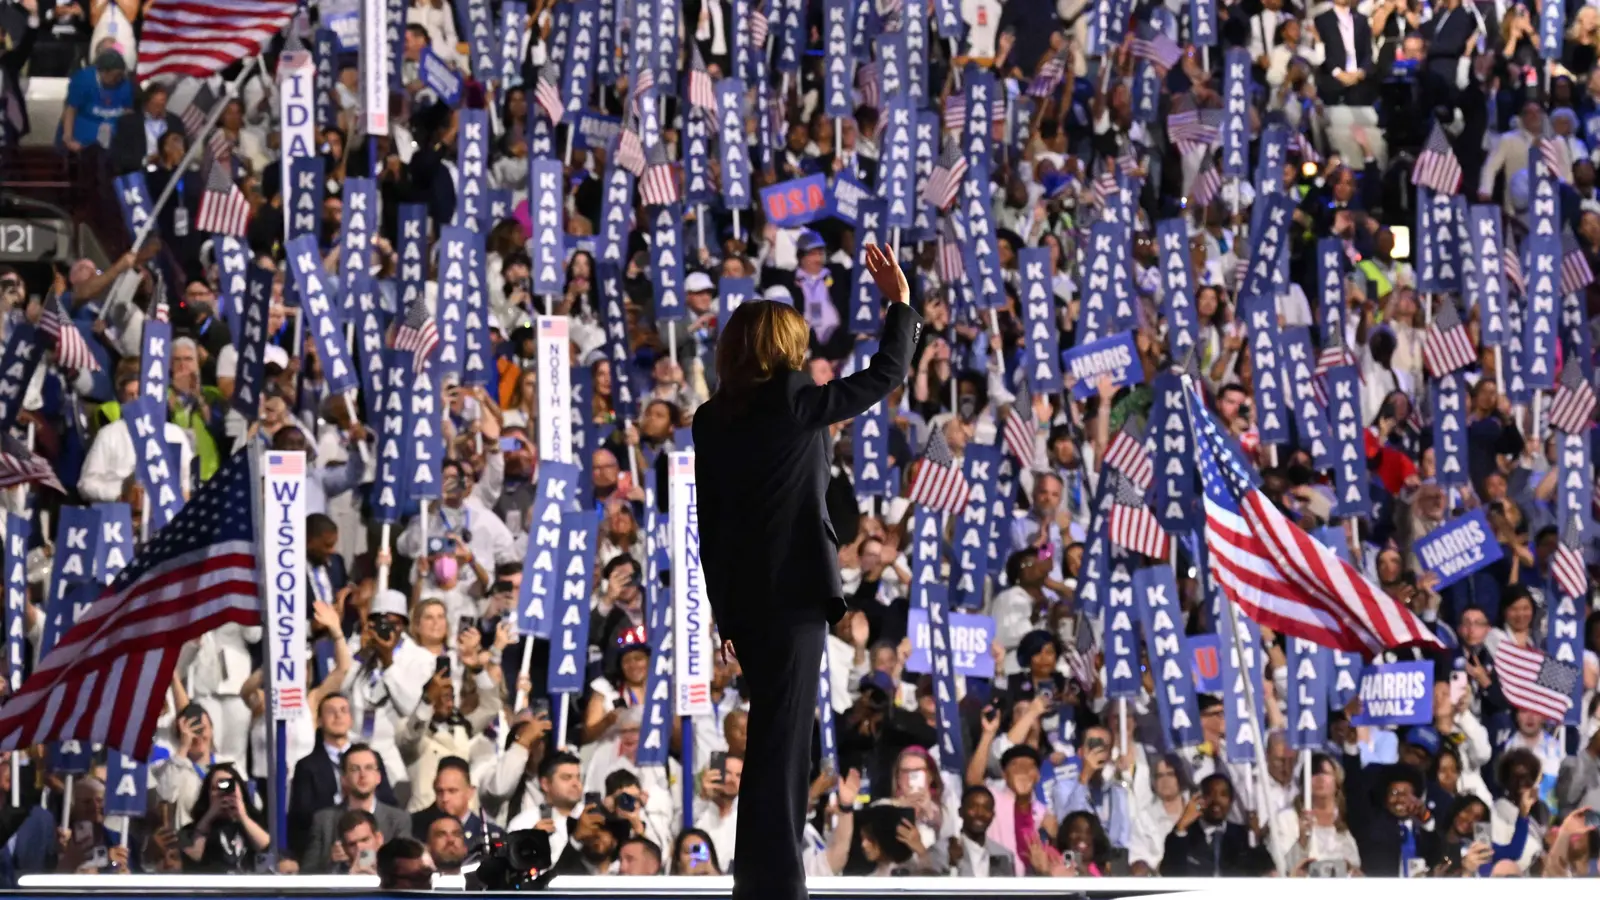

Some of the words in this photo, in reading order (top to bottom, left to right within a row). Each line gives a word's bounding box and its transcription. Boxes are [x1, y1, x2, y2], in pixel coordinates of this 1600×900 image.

[387, 0, 402, 74] MALA
[469, 0, 495, 70] MALA
[501, 11, 519, 98] KAMAL
[567, 11, 592, 112] KAMALA
[597, 0, 613, 74] MALA
[657, 0, 676, 85] AMALA
[736, 1, 749, 80] KAMAL
[782, 0, 802, 62] MALA
[829, 7, 847, 107] KAMALA
[882, 44, 899, 93] KAM
[907, 3, 923, 96] KAMALA
[1545, 0, 1559, 49] ALA
[287, 75, 310, 157] IDA
[317, 41, 333, 124] KAMAL
[643, 96, 661, 148] KAM
[969, 85, 988, 168] KAMA
[1140, 64, 1157, 110] ALA
[1229, 63, 1246, 166] KAMALA
[688, 106, 706, 192] AMALA
[723, 92, 745, 197] KAMALA
[893, 109, 911, 215] KAMALA
[295, 171, 315, 230] KAM
[539, 172, 558, 282] KAMALA
[604, 168, 628, 259] AMALA
[767, 184, 825, 220] USA
[964, 180, 999, 295] KAMALA
[1433, 195, 1456, 280] AMALA
[1535, 160, 1555, 235] KAMA
[401, 220, 422, 313] KAMA
[656, 209, 679, 307] AMALA
[1165, 232, 1193, 346] KAMALA
[1250, 206, 1286, 294] KAMAL
[1324, 251, 1341, 335] KAMA
[1480, 218, 1504, 333] KAMALA
[240, 279, 265, 404] KAMALA
[297, 252, 348, 378] KAMALA
[441, 240, 464, 362] KAMALA
[605, 279, 632, 403] KAMALA
[1027, 261, 1053, 379] KAMALA
[1508, 299, 1525, 392] AMALA
[1531, 254, 1554, 375] KAMALA
[146, 337, 164, 403] KAM
[550, 344, 560, 407] NORTH
[1070, 344, 1132, 380] HARRIS
[1252, 310, 1281, 430] KAMALA
[1289, 343, 1327, 456] KAMALA
[136, 415, 177, 522] KAMA
[380, 368, 404, 506] KAMALA
[412, 362, 434, 482] AMALA
[1164, 390, 1186, 519] KAMALA
[1336, 381, 1362, 503] KAMALA
[1438, 376, 1461, 475] AMALA
[958, 460, 990, 592] KAMALA
[988, 441, 1012, 559] AMALA
[1421, 520, 1486, 570] HARRIS
[272, 481, 300, 681] WISCONSIN
[525, 478, 568, 619] KAMALA
[685, 483, 701, 676] TENNESSEE
[1439, 552, 1485, 578] WALZ
[557, 530, 588, 675] KAMALA
[1555, 599, 1577, 662] AMA
[1147, 584, 1193, 728] KAMALA
[1230, 616, 1254, 744] AMALA
[1295, 640, 1318, 731] MALA
[1360, 671, 1426, 700] HARRIS
[1368, 700, 1415, 717] WALZ
